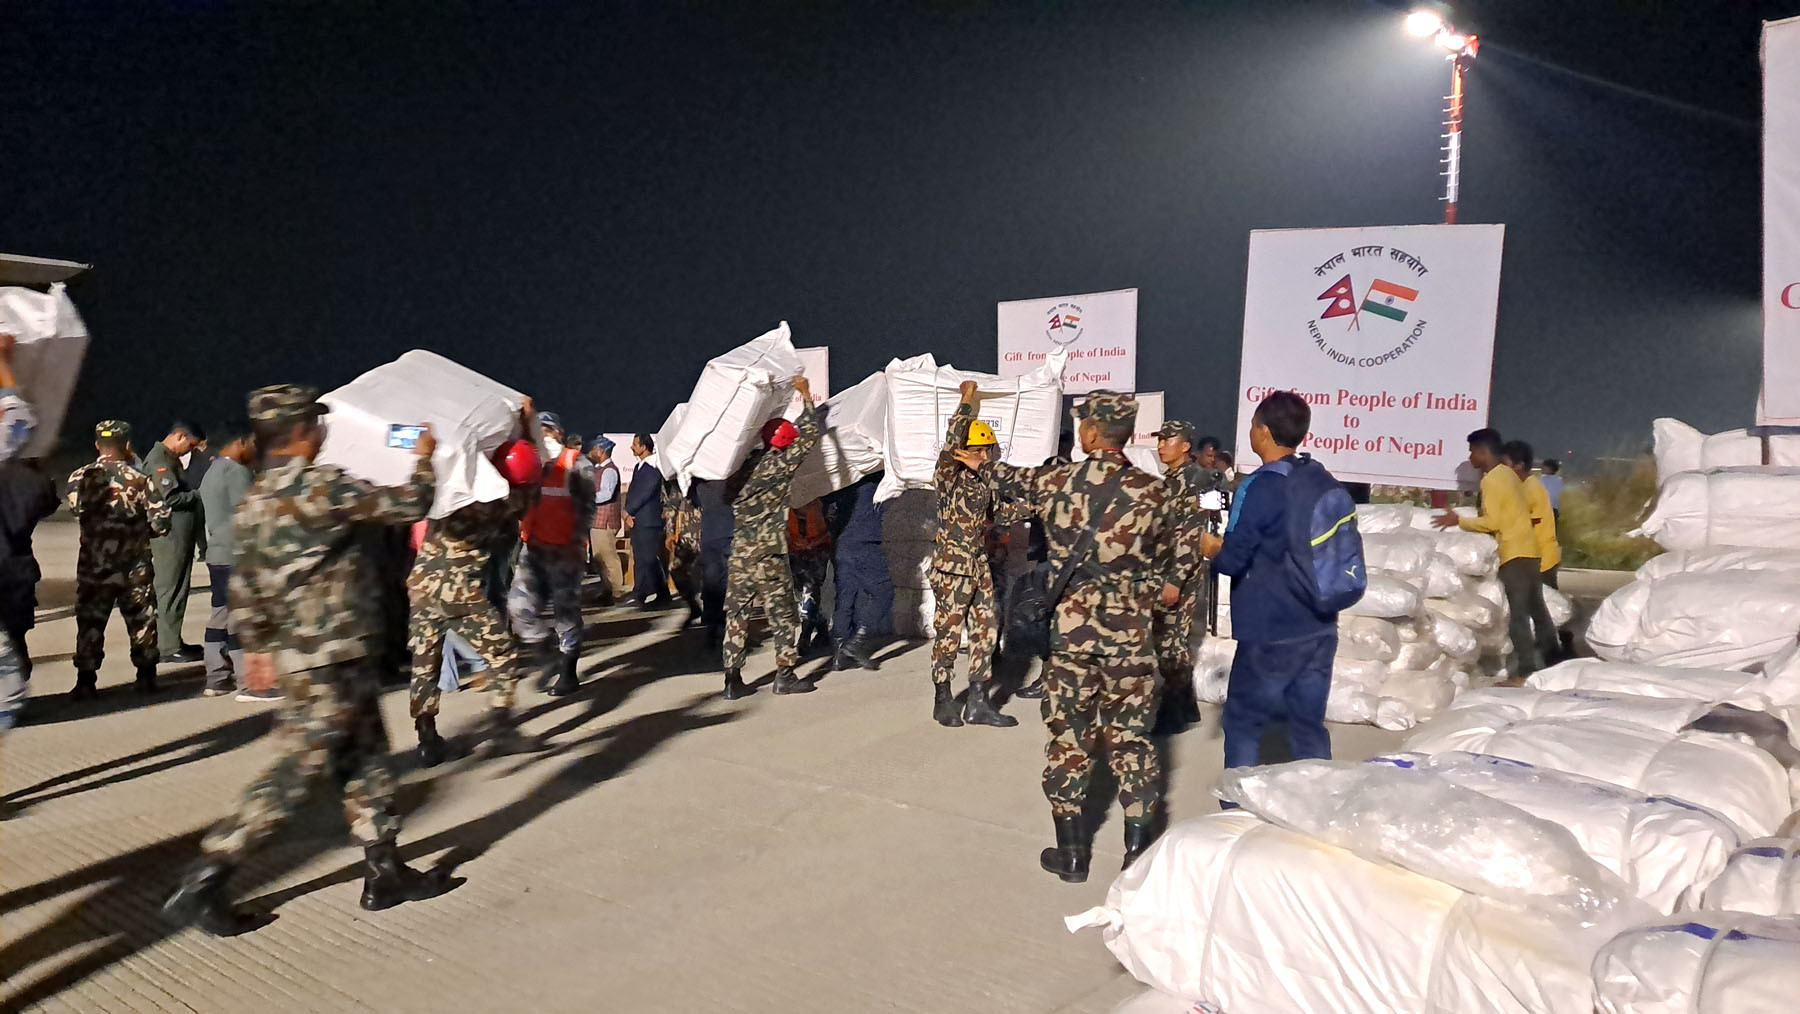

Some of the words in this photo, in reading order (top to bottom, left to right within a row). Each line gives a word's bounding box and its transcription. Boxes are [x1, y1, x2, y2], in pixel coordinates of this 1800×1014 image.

[1314, 252, 1346, 277] नेपाल
[1351, 245, 1384, 257] भारत
[1390, 247, 1429, 278] सहयोग
[1004, 351, 1023, 362] Gift
[1087, 347, 1098, 358] of
[1100, 346, 1127, 357] India
[1307, 319, 1328, 352] NEPAL
[1326, 347, 1355, 367] INDIA
[1358, 319, 1427, 368] COOPERATION
[1069, 373, 1080, 383] of
[1082, 371, 1111, 384] Nepal
[1337, 389, 1396, 412] People
[1401, 391, 1420, 409] of
[1426, 392, 1478, 412] India
[1343, 413, 1361, 429] to
[1303, 431, 1359, 455] People
[1364, 436, 1383, 453] of
[1388, 436, 1444, 460] Nepal
